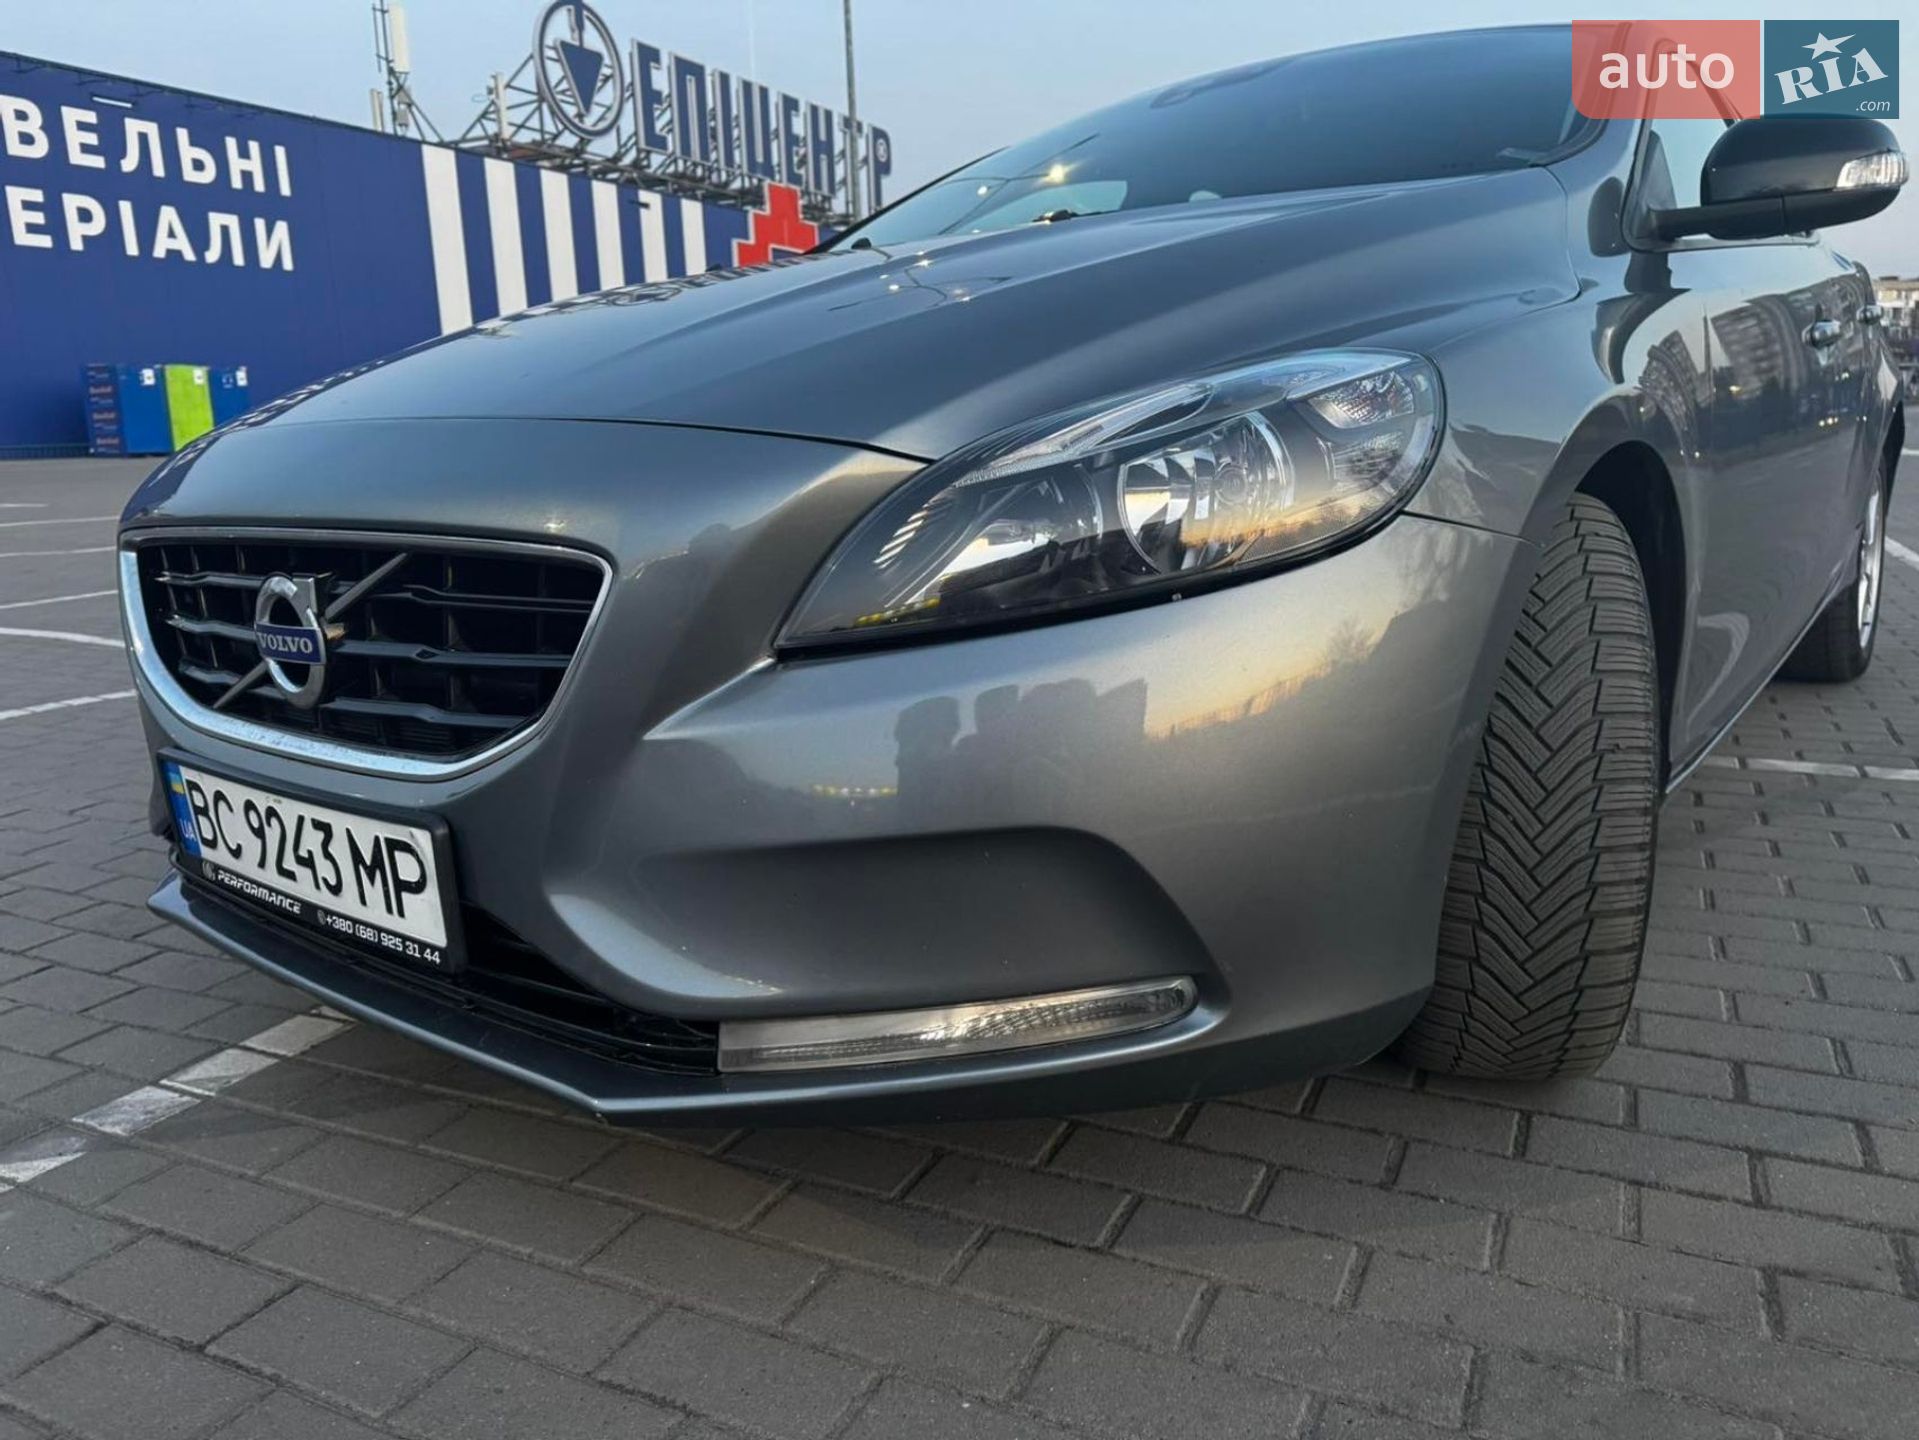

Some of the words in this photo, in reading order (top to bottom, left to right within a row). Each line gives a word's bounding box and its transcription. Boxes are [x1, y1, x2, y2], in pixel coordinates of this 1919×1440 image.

[0, 94, 291, 197] ВЕЛЬНІ
[4, 185, 294, 271] ЕРІАЛИ
[257, 632, 313, 654] VOLVO
[180, 818, 198, 843] UA
[185, 778, 242, 860] BC
[243, 798, 343, 897] 9243
[346, 826, 428, 919] MP
[217, 869, 302, 915] PERFORMANCE
[326, 914, 353, 934] +380
[355, 923, 379, 943] (68)
[380, 932, 403, 952] 925
[405, 941, 421, 958] 31
[423, 948, 441, 964] 44
